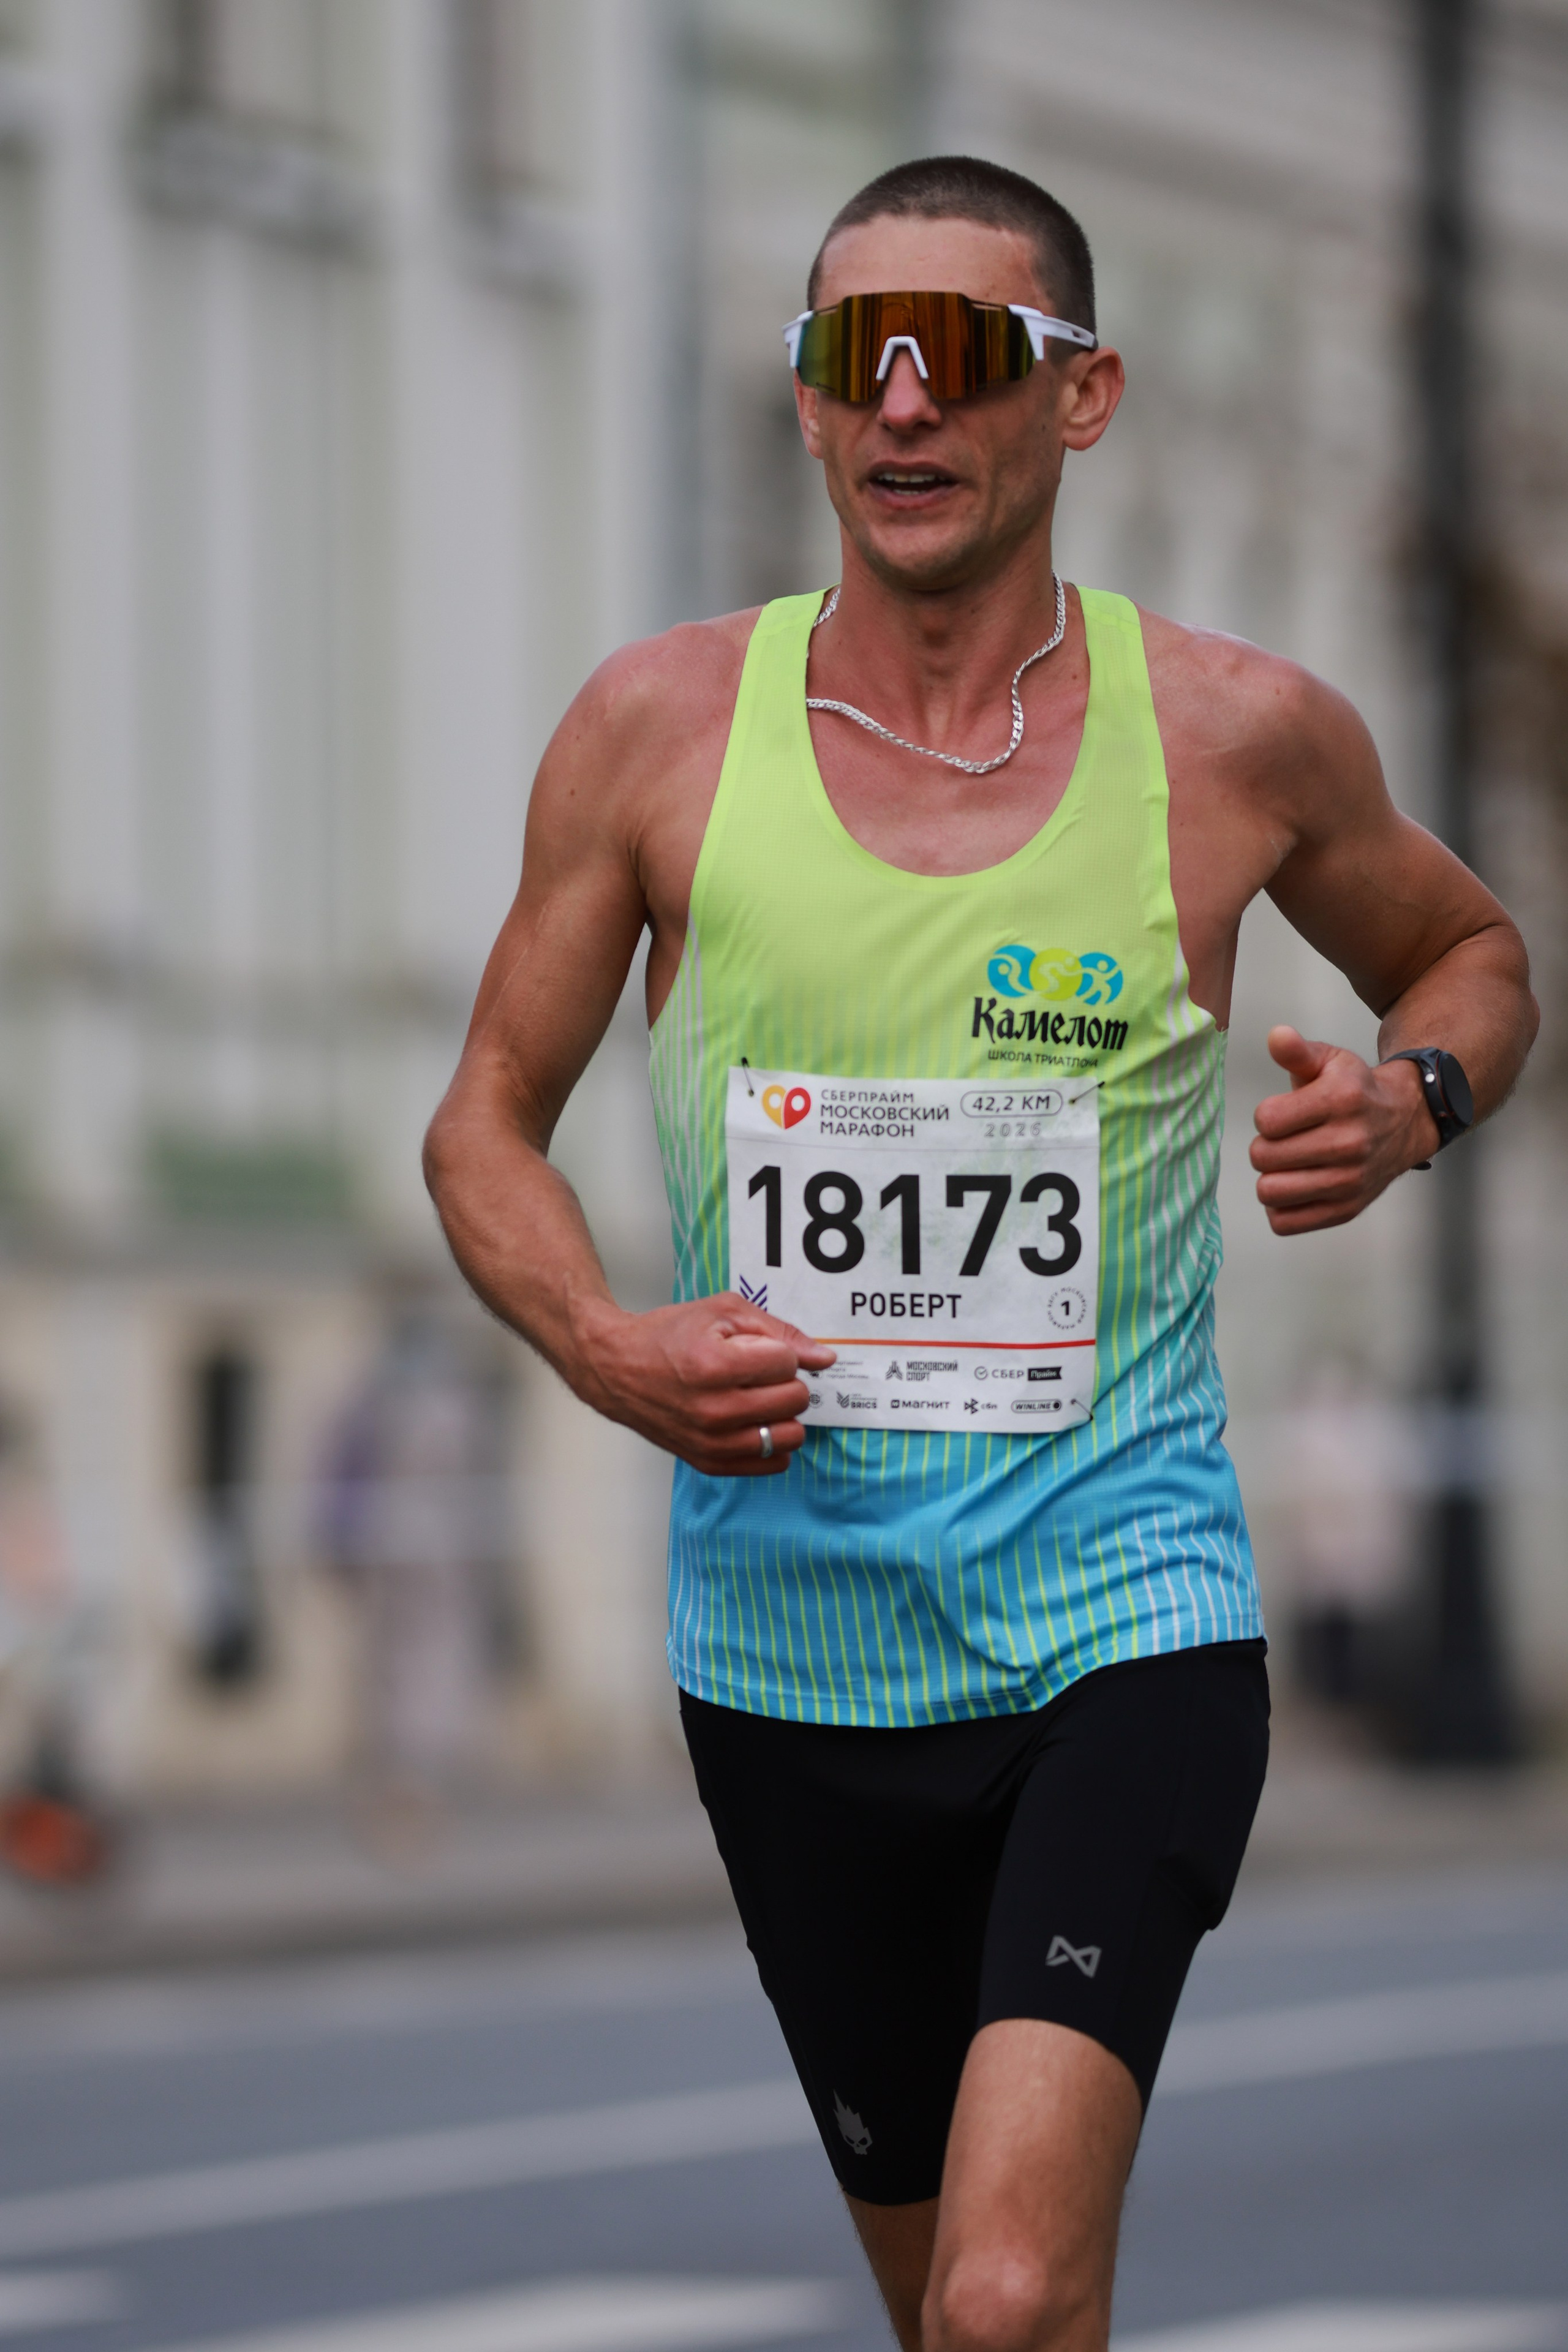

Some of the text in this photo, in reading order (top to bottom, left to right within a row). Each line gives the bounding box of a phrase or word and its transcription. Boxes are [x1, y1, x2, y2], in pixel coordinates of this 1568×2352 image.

[971, 996, 1128, 1050] Камелот
[987, 1049, 1099, 1068] ШКОЛА ТРИАТЛОНА
[821, 1088, 914, 1103] СБЕРПРАЙМ
[972, 1095, 1050, 1112] 42,2 КМ
[820, 1104, 949, 1121] МОСКОВСКИЙ
[820, 1121, 914, 1137] МАРАФОН
[984, 1121, 1041, 1138] 2026
[748, 1165, 1082, 1276] 18173
[851, 1292, 962, 1318] РОБЕРТ
[1061, 1300, 1069, 1316] 1
[906, 1360, 958, 1371] МОСКОВСКИЙ
[991, 1368, 1024, 1379] СБЕР
[906, 1372, 930, 1381] СПОРТ
